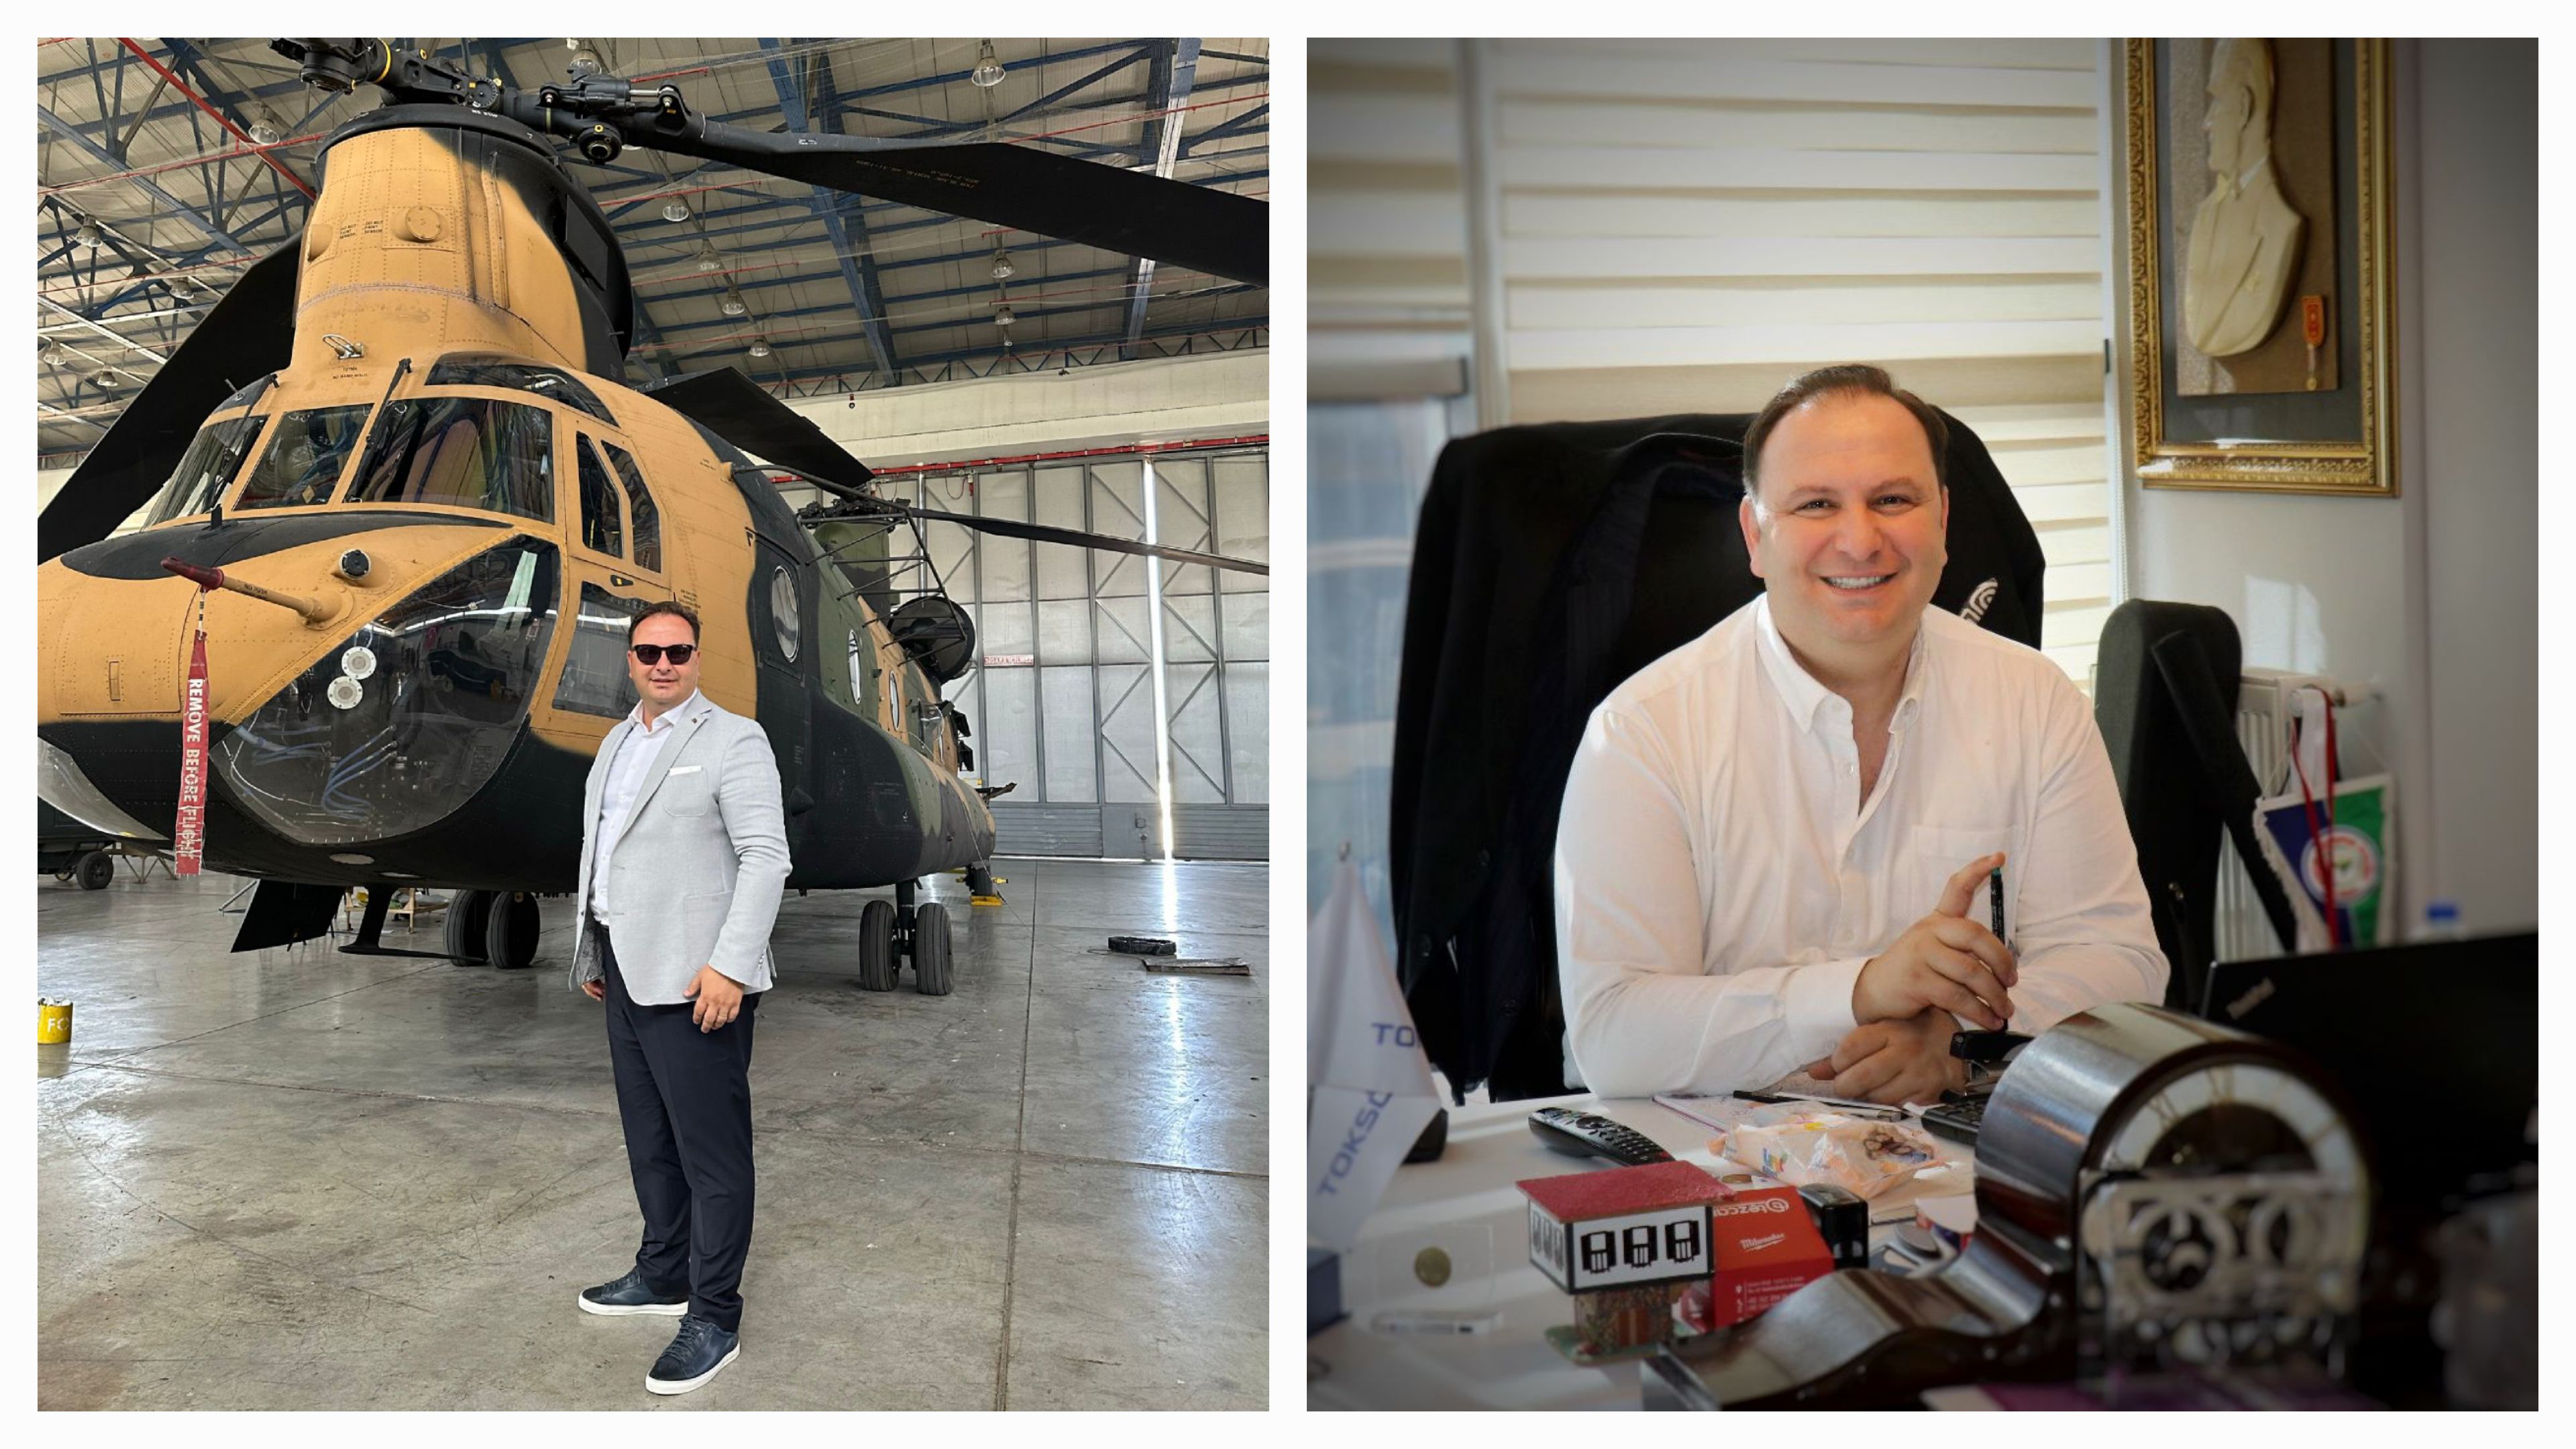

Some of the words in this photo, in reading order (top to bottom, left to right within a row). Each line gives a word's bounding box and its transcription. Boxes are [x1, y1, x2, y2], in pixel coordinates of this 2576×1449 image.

[186, 678, 204, 743] REMOVE
[183, 748, 201, 803] BEFORE
[1371, 1021, 1421, 1048] TO
